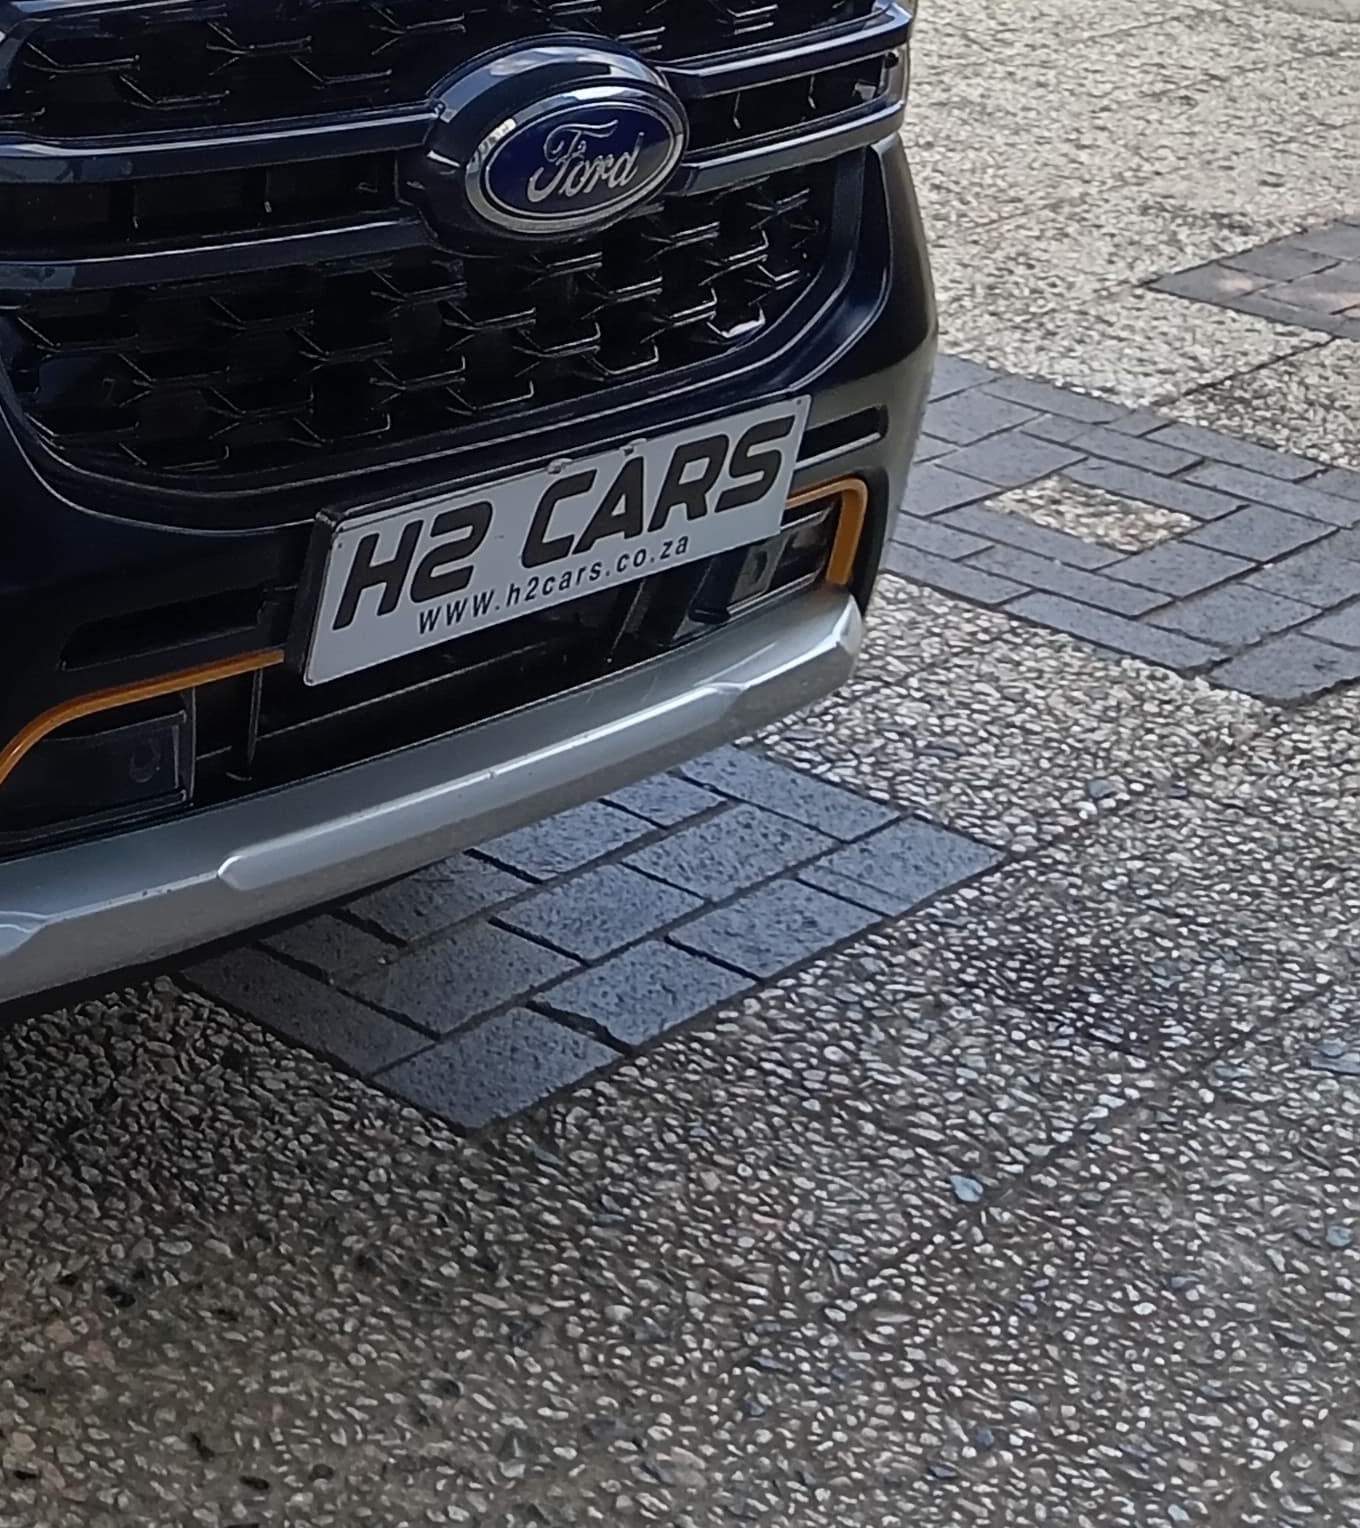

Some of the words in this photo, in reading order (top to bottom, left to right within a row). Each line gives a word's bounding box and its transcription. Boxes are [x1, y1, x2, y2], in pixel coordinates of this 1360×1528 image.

[527, 119, 646, 203] Ford
[331, 501, 494, 631] H2
[521, 414, 796, 570] CARS
[416, 533, 689, 635] www.h2cars.co.za
